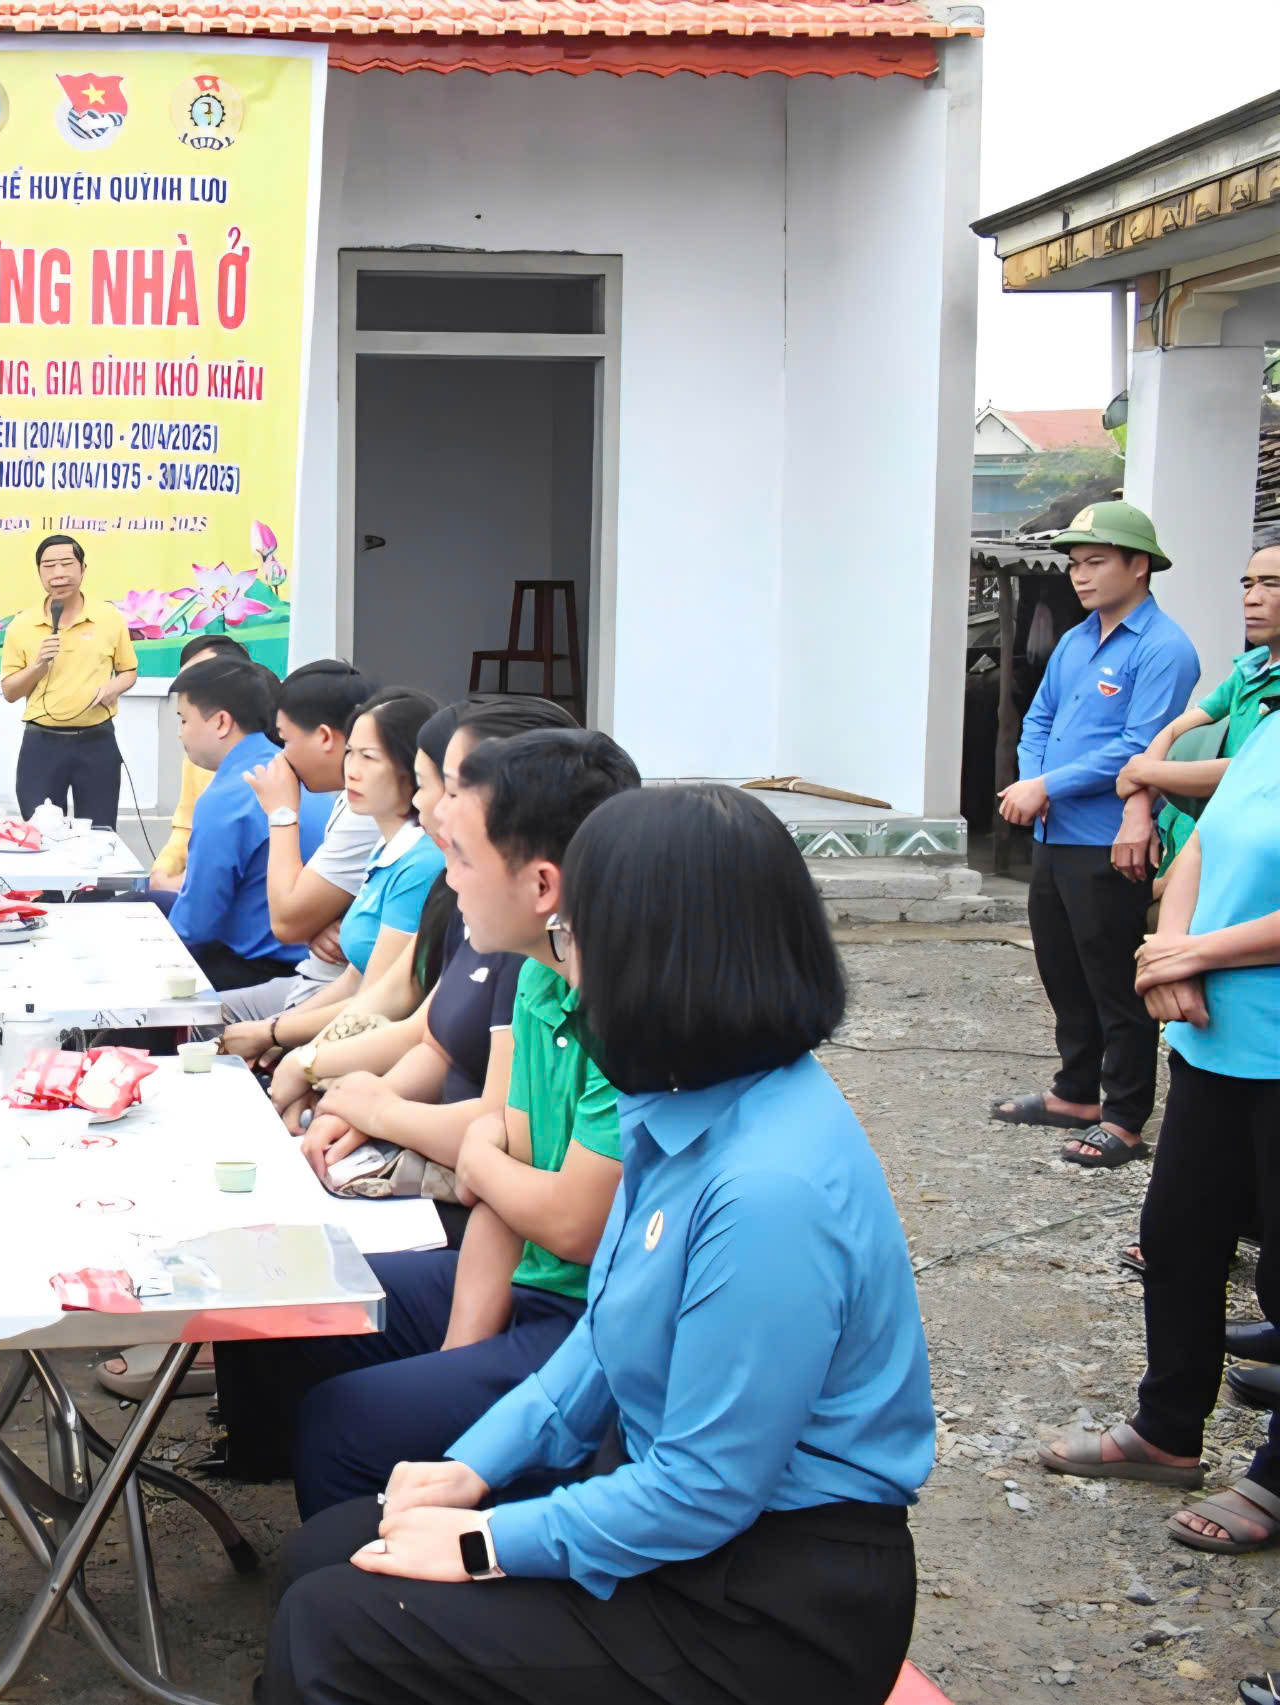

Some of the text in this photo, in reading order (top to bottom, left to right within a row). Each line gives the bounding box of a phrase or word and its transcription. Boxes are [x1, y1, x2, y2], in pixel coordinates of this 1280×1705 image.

[29, 171, 102, 205] HUYỆN
[109, 171, 182, 202] QUỲNH
[190, 176, 228, 204] LƯU
[91, 233, 200, 326] NHÀ
[217, 226, 250, 329] Ở
[46, 360, 82, 395] GIA
[155, 354, 199, 397] KHÓ
[208, 359, 264, 401] KHĂN
[23, 421, 114, 451] (20/4/1930
[131, 422, 218, 453] 20/4/2025)
[51, 461, 141, 490] (30/4/1975
